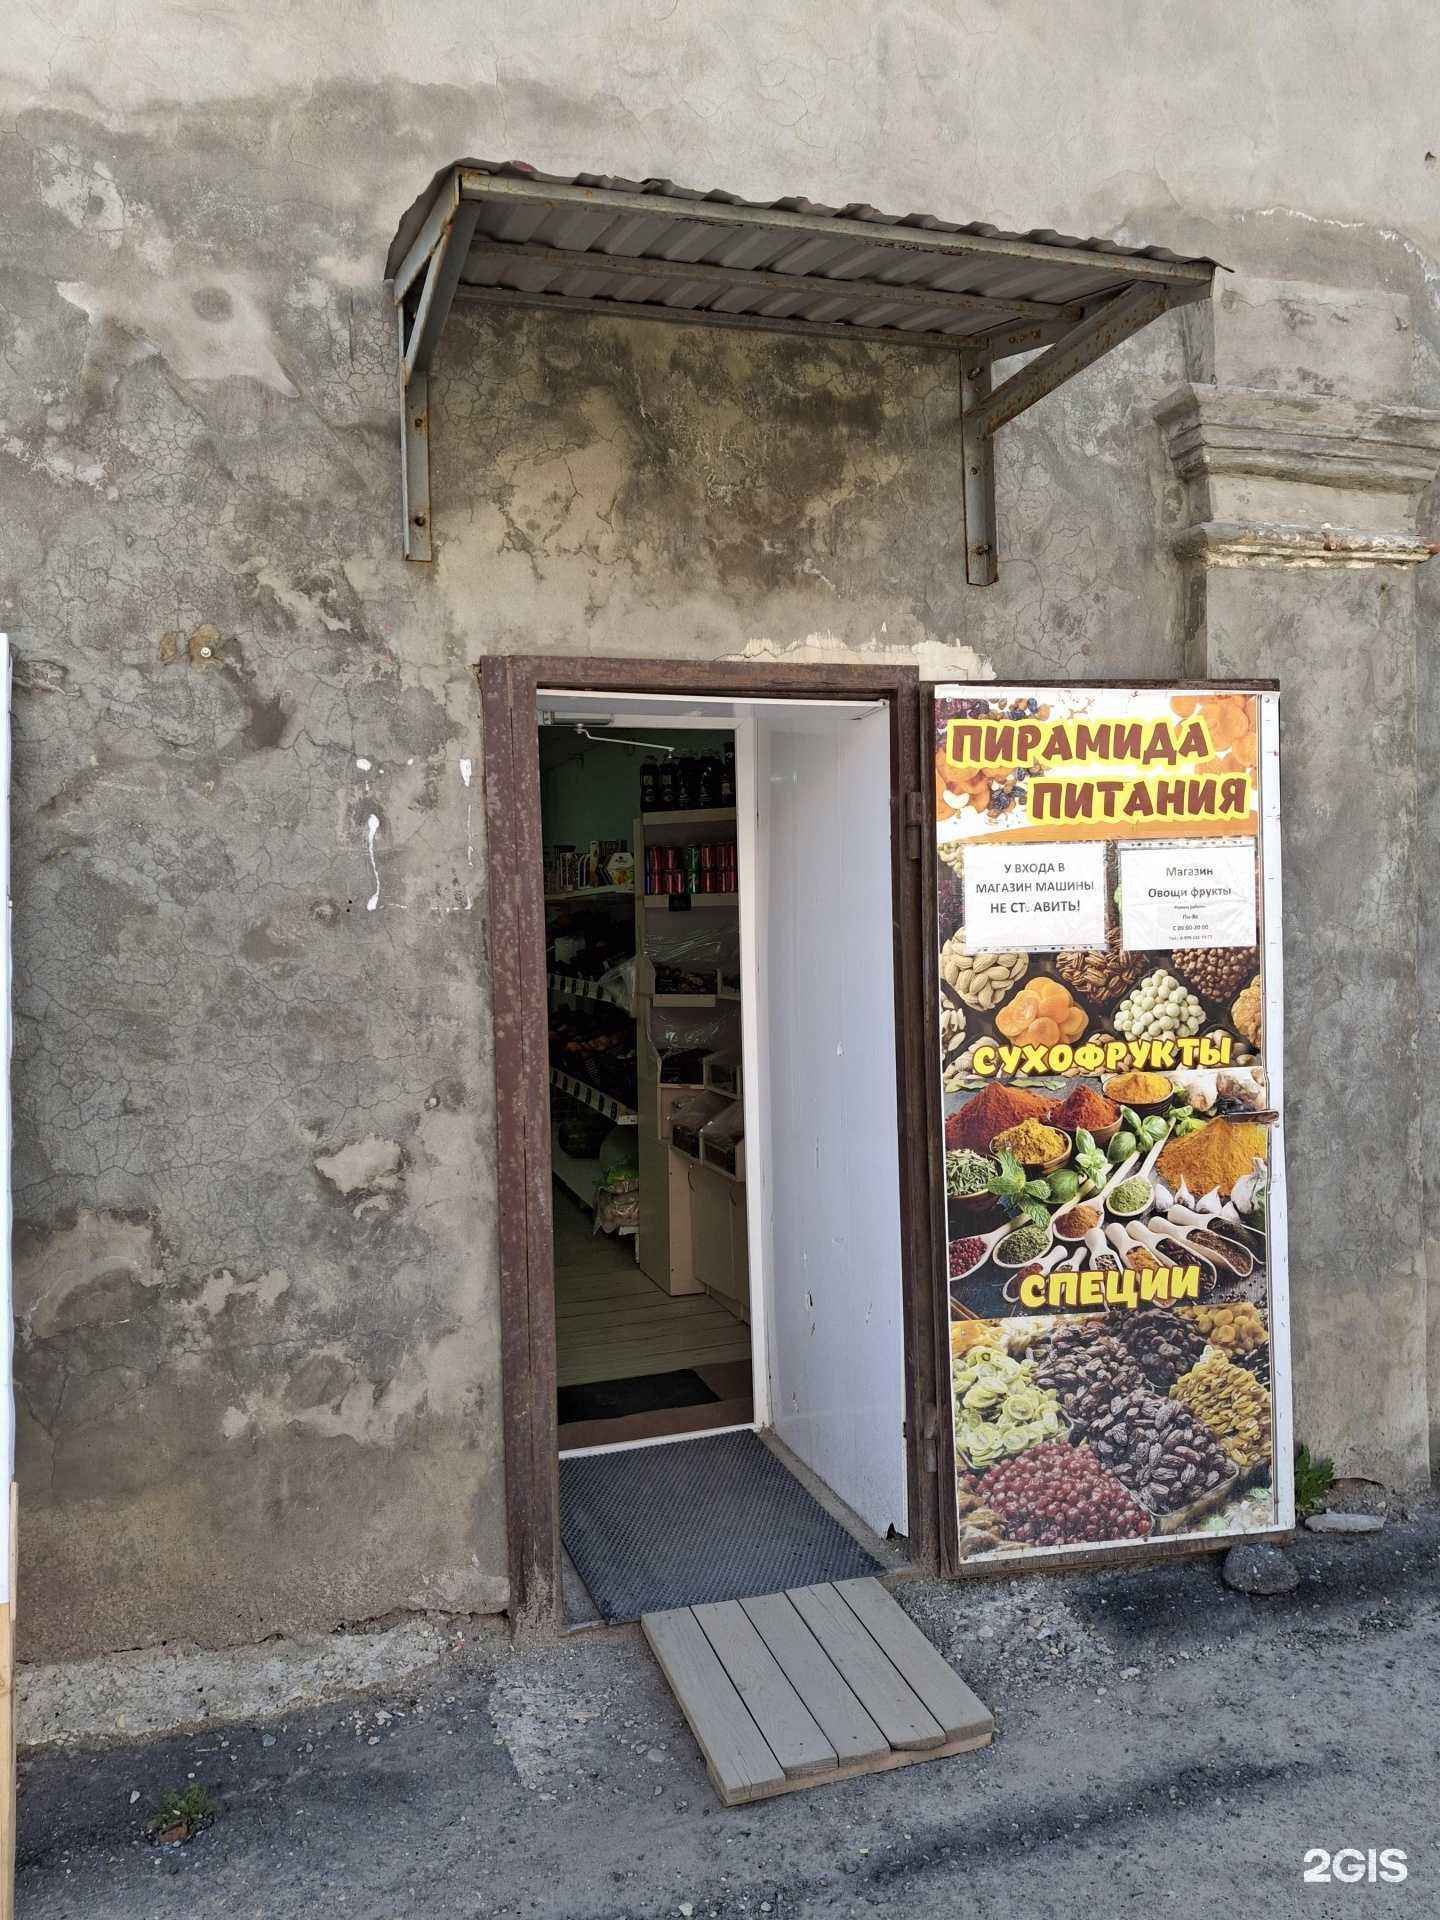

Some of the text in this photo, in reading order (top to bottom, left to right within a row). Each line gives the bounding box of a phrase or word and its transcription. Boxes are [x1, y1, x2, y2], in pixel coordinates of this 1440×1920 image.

[950, 720, 1211, 766] ПИРАМИДА
[1031, 777, 1248, 820] ПИТАНИЯ
[1004, 862, 1065, 875] У ВХОДА В
[1166, 867, 1213, 877] Магазин
[976, 881, 1095, 893] МАГАЗИН МАШИНЫ
[1148, 886, 1232, 899] Овощи фрукты
[990, 902, 1007, 913] НЕ
[1033, 900, 1081, 913] АВИТЬ!
[972, 1037, 1232, 1076] СУХОФРУКТЫ
[1020, 1265, 1201, 1309] СПЕЦИИ
